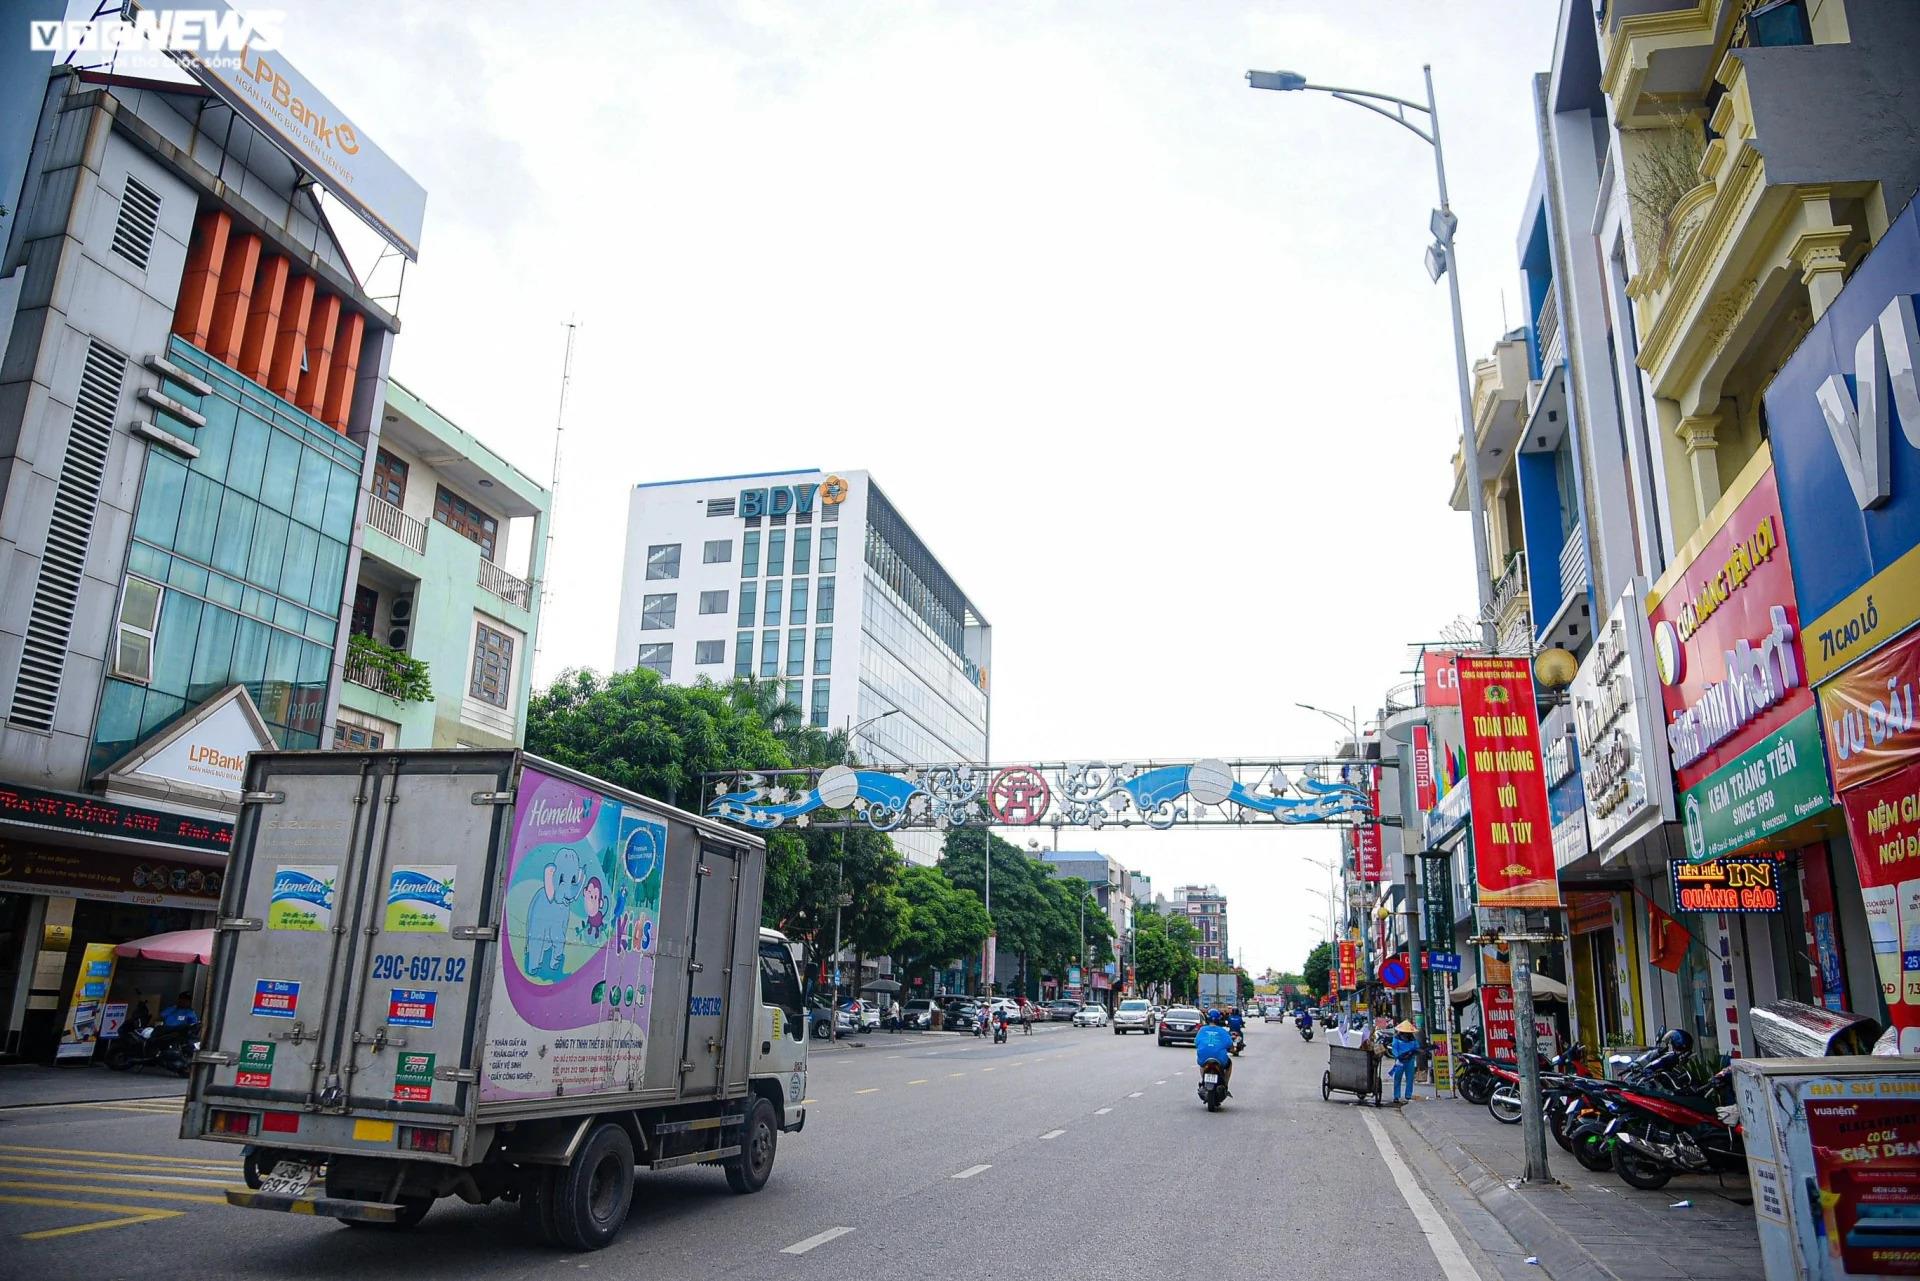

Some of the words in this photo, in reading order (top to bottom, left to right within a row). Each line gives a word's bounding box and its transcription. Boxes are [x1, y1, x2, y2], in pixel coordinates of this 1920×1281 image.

[236, 74, 262, 100] NGÂN
[240, 45, 334, 149] LPBank
[739, 483, 819, 518] BIDV
[1693, 570, 1730, 625] HÀNG
[1724, 544, 1754, 591] TIỆN
[1748, 516, 1777, 566] LỢI
[1819, 629, 1836, 661] 71
[1835, 619, 1860, 650] CAO
[1859, 595, 1878, 634] LỖ
[1724, 605, 1799, 728] Mart
[1867, 675, 1913, 746] ĐÃI
[1473, 712, 1502, 738] TOÀN
[1503, 713, 1528, 737] DÂN
[190, 744, 243, 771] LPBank
[1415, 748, 1429, 787] CANIFA
[1474, 747, 1495, 772] NÓI
[1495, 747, 1534, 773] KHÔNG
[1707, 781, 1730, 814] KEM
[1729, 759, 1767, 801] TRÀNG
[1766, 736, 1797, 780] TIỀN
[1498, 783, 1518, 808] VỚI
[1732, 798, 1757, 826] SINCE
[1756, 790, 1775, 814] 1958
[529, 798, 584, 827] Homelux
[1867, 799, 1899, 838] NỆM
[1491, 823, 1510, 844] MA
[1510, 819, 1533, 844] TÚY
[1879, 833, 1905, 866] NGỦ
[272, 879, 323, 893] Homelux
[389, 879, 441, 894] Homelux
[1727, 863, 1770, 887] IN
[1681, 883, 1738, 909] QUẢNG
[1741, 886, 1776, 909] CÁO
[373, 955, 466, 982] 29C-697.92
[1904, 956, 1920, 970] -25
[275, 982, 289, 991] Delo
[411, 991, 426, 1000] Delo
[246, 1052, 267, 1060] CRB
[404, 1064, 426, 1072] CRB
[1814, 1104, 1856, 1118] vuanệm
